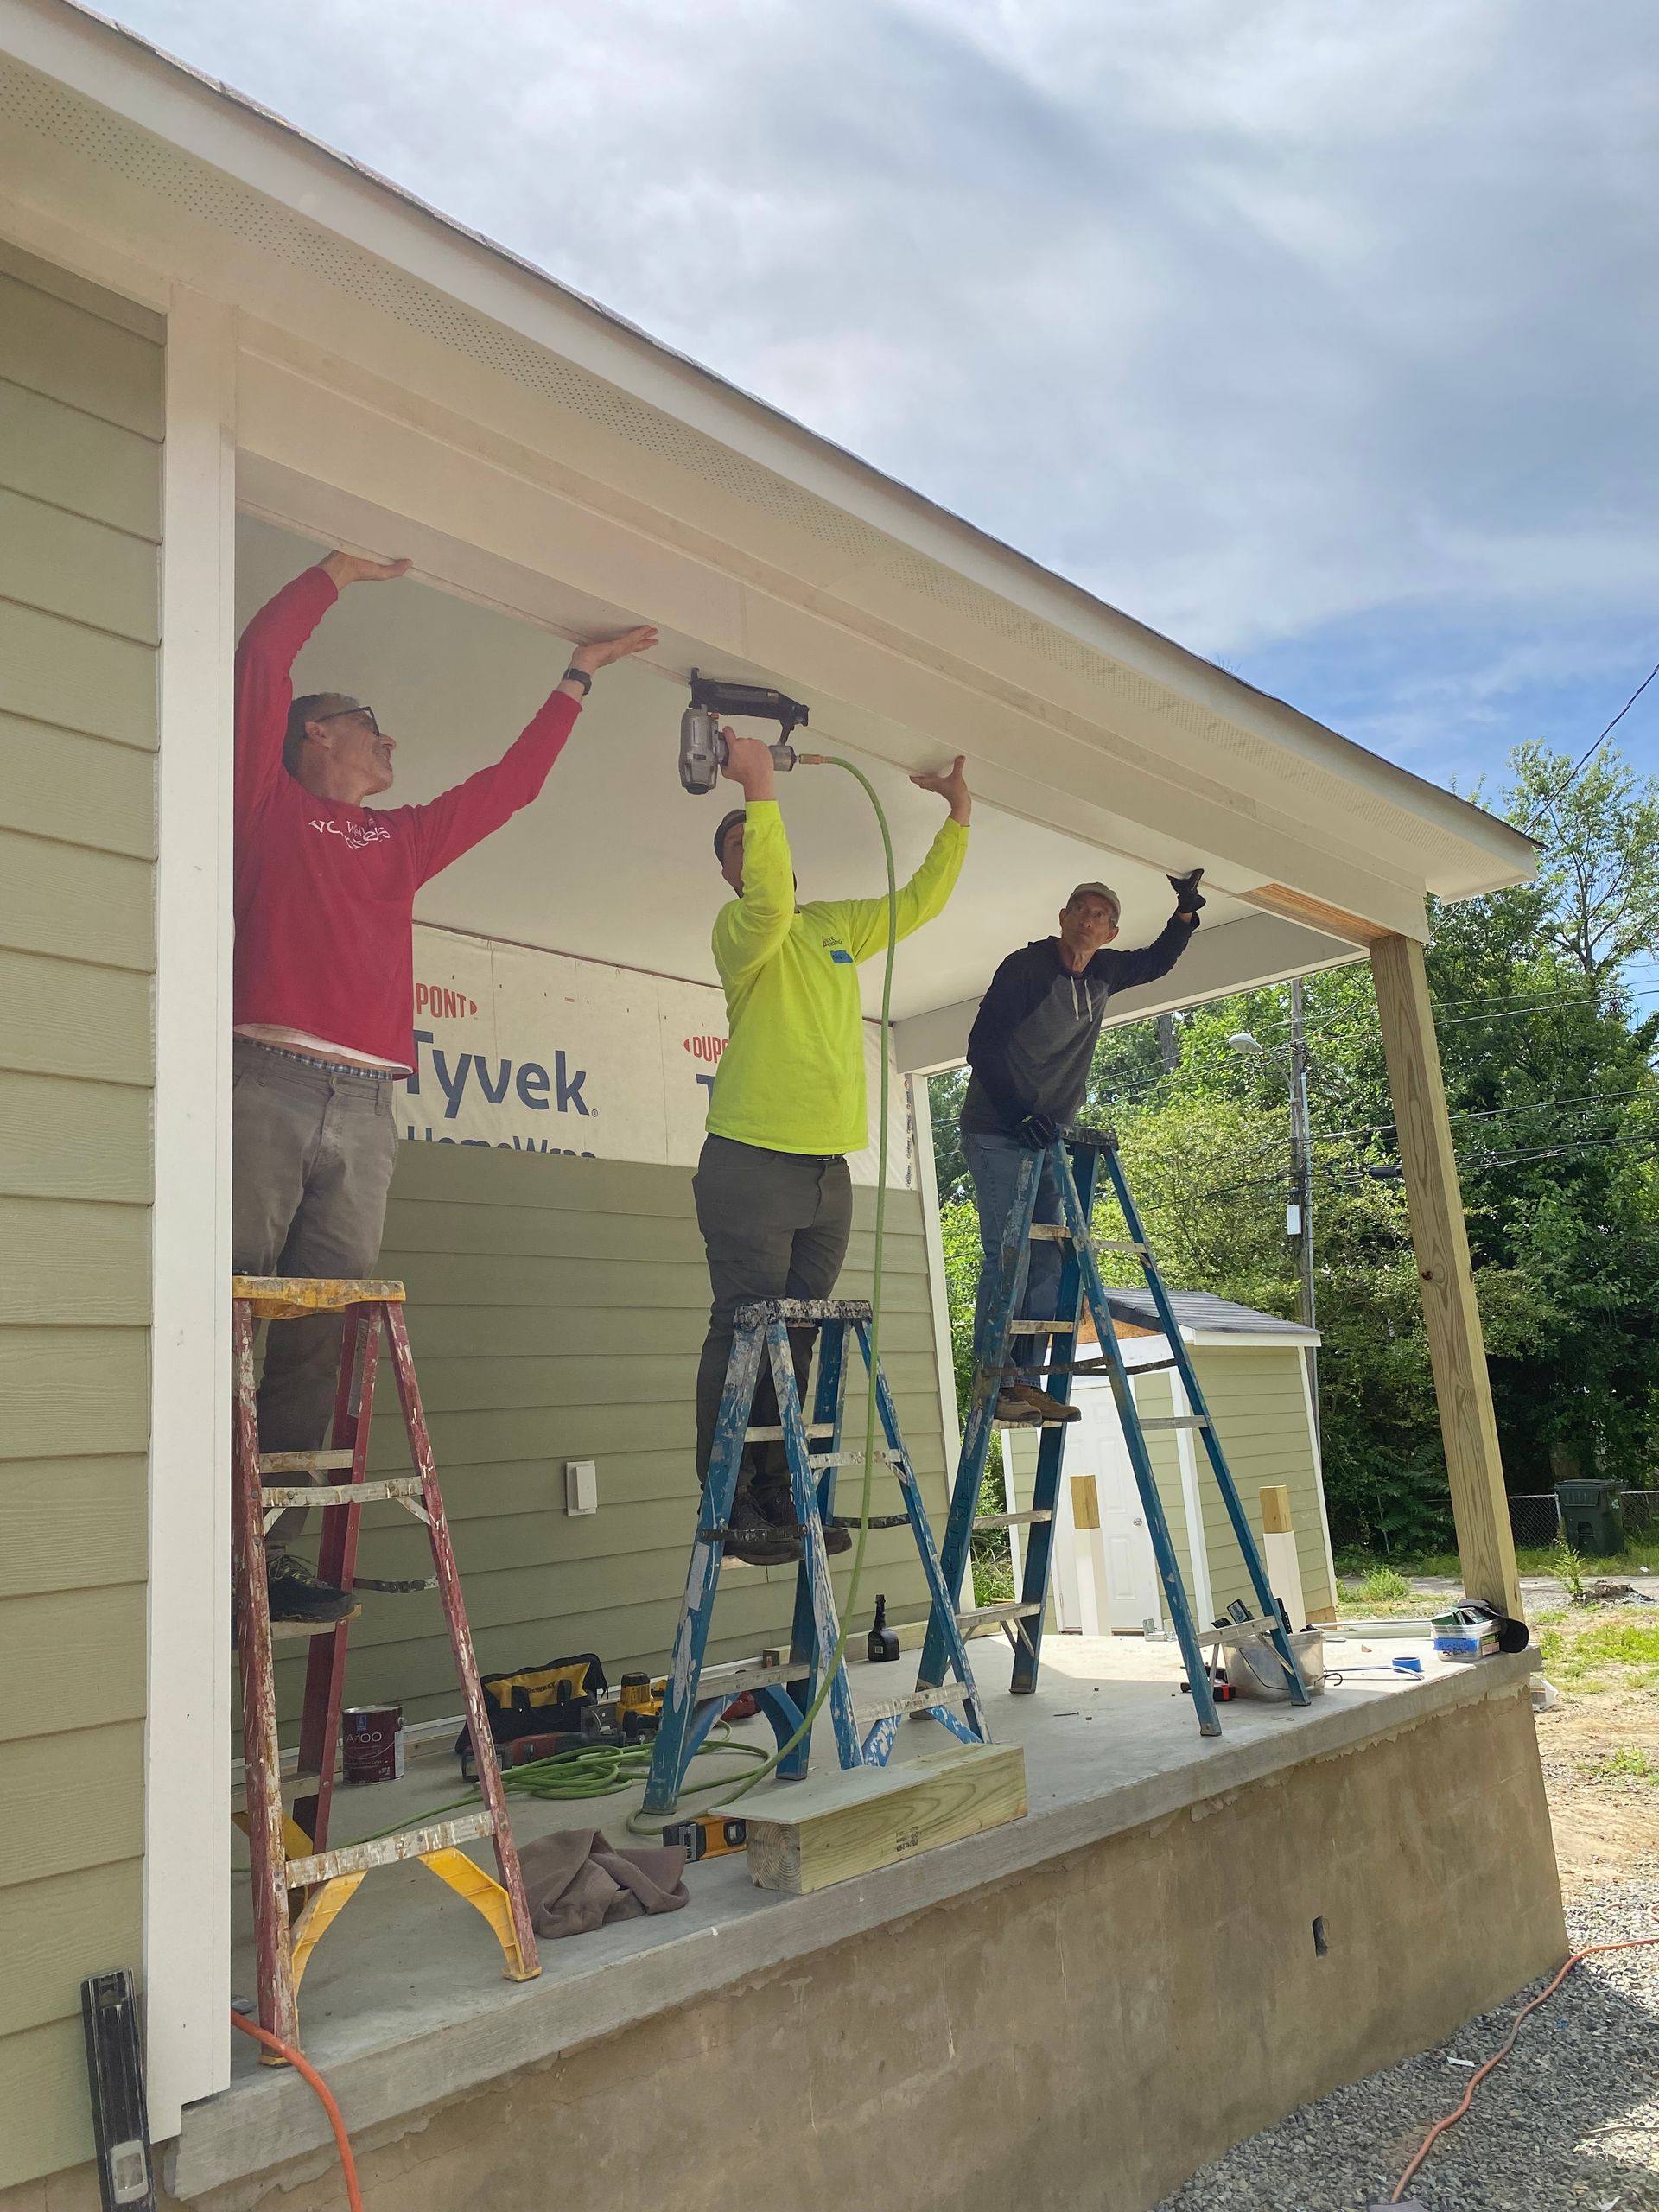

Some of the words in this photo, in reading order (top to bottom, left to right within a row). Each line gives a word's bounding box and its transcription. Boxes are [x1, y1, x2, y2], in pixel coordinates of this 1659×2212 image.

[416, 982, 467, 1019] PONT
[692, 1036, 730, 1064] DUP
[406, 1029, 590, 1119] Tyvek
